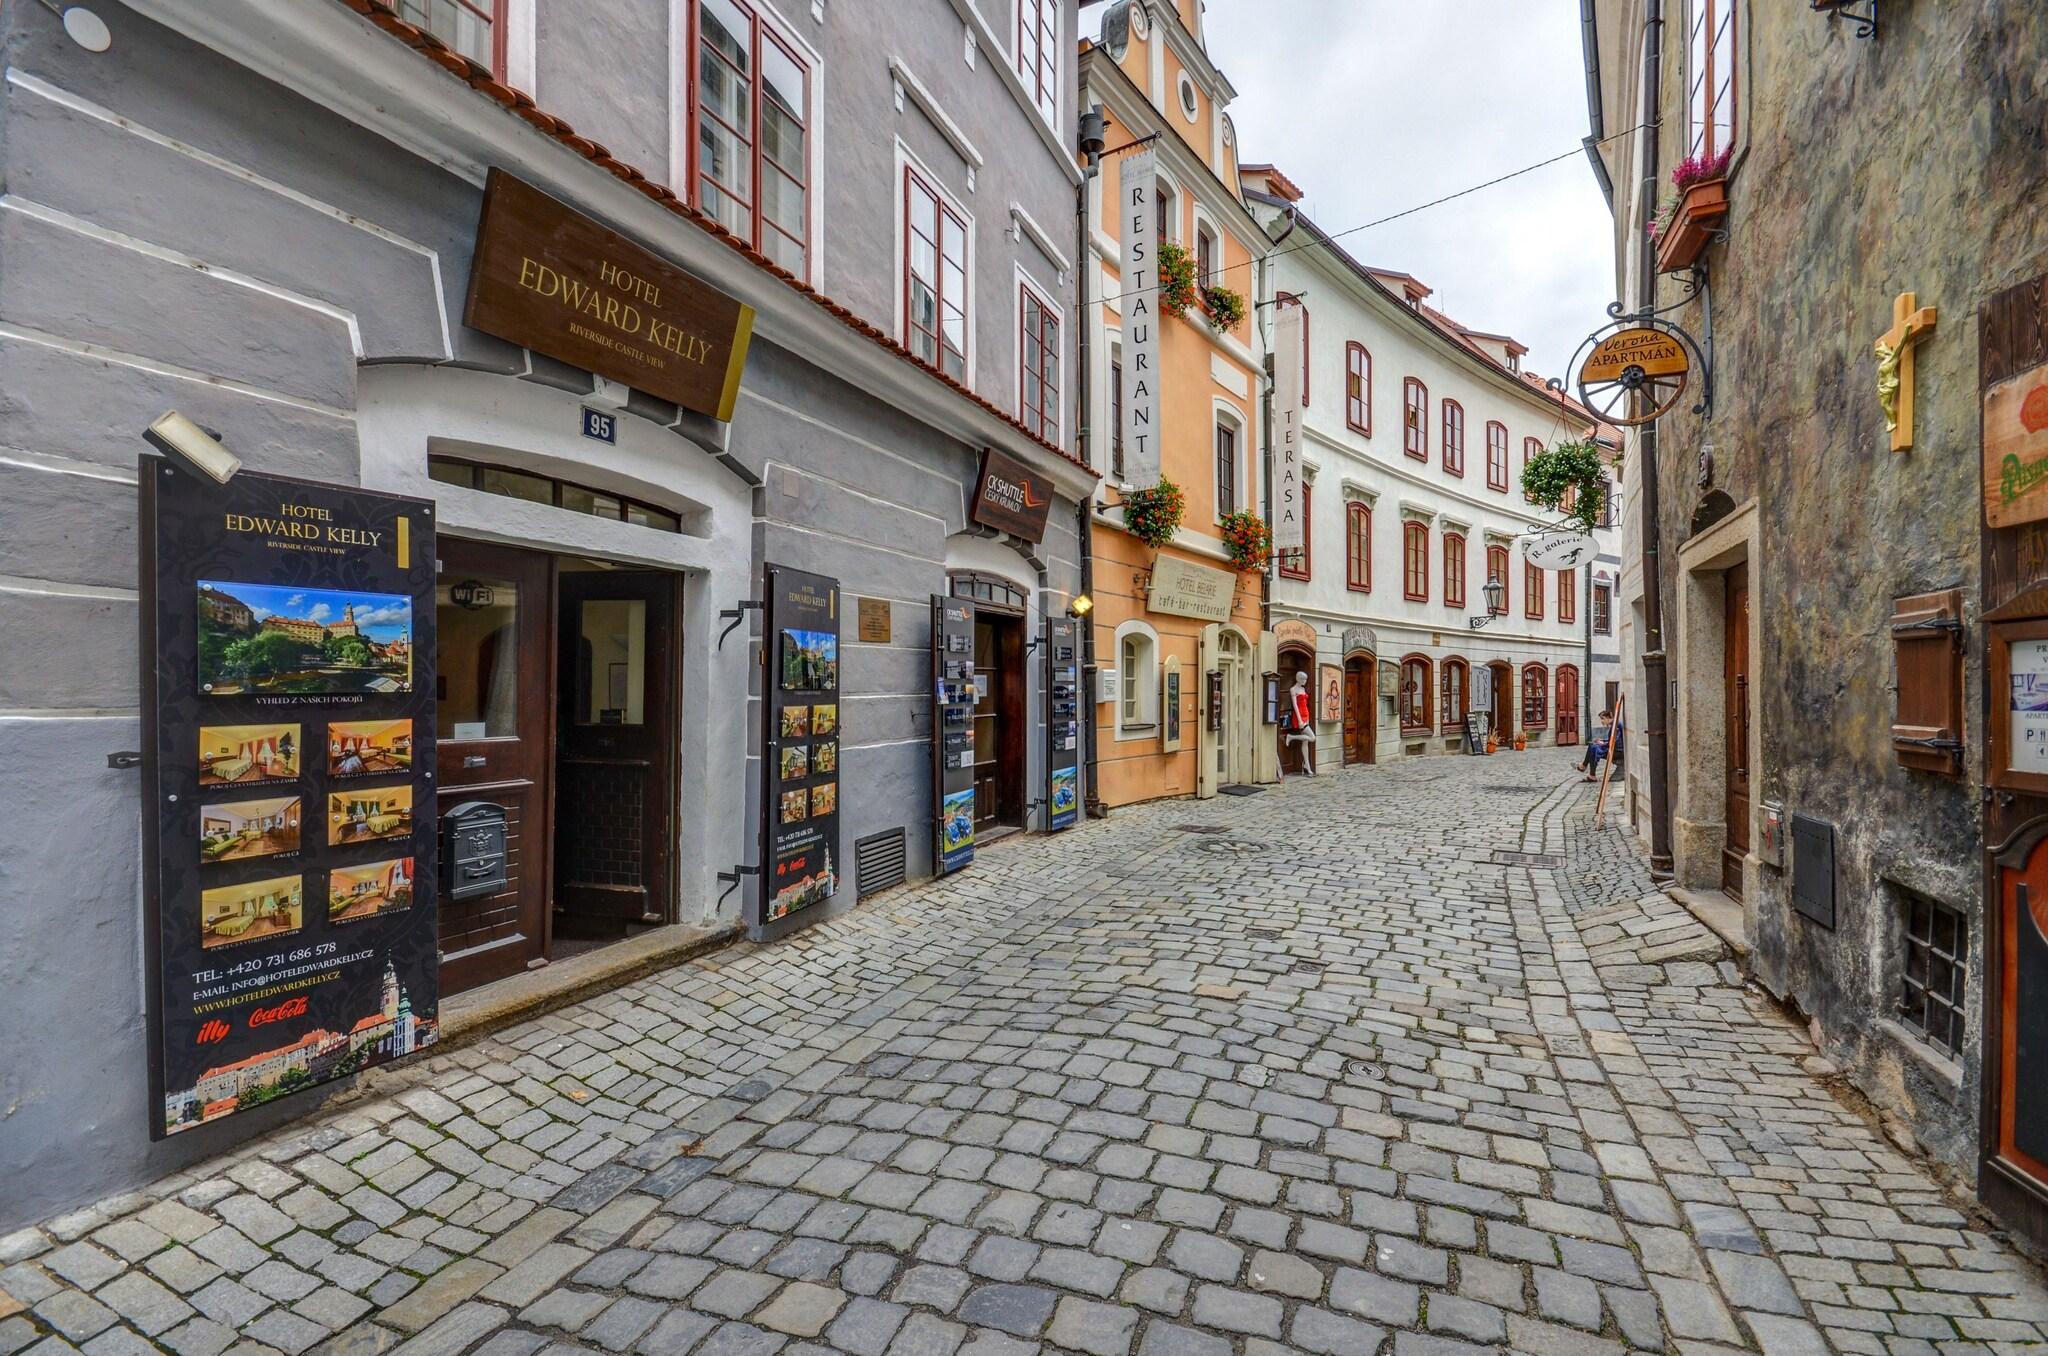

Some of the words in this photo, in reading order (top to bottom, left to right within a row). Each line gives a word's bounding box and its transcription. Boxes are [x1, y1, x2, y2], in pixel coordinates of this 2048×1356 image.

[600, 261, 662, 308] HOTEL
[519, 257, 641, 334] EDWARD
[648, 318, 713, 366] KELLY
[1132, 187, 1150, 454] RESTAURANT
[569, 322, 614, 349] RIVERSIDE
[615, 342, 645, 360] CASTLE
[646, 354, 666, 369] VIEW
[1591, 345, 1676, 366] APARTMÁN
[1605, 333, 1661, 351] Verona
[590, 414, 610, 437] 95
[1283, 409, 1295, 524] TERASA
[988, 474, 998, 491] CK
[997, 480, 1024, 503] SHUTTLE
[225, 514, 319, 539] EDWARD
[327, 527, 382, 547] KELLY
[282, 503, 333, 522] HOTEL
[1532, 550, 1544, 559] R.
[1545, 536, 1583, 552] galerie
[192, 970, 223, 985] TEL:
[226, 959, 261, 977] +420
[266, 953, 285, 968] 731
[289, 947, 312, 962] 686
[315, 942, 337, 956] 578
[193, 986, 230, 1001] E-MAIL:
[232, 949, 374, 991] INFO@HOTELEDWARDKELLY.CZ
[193, 971, 341, 1015] WWW.HOTELEDWARDKELLY.CZ
[197, 1019, 231, 1044] illy
